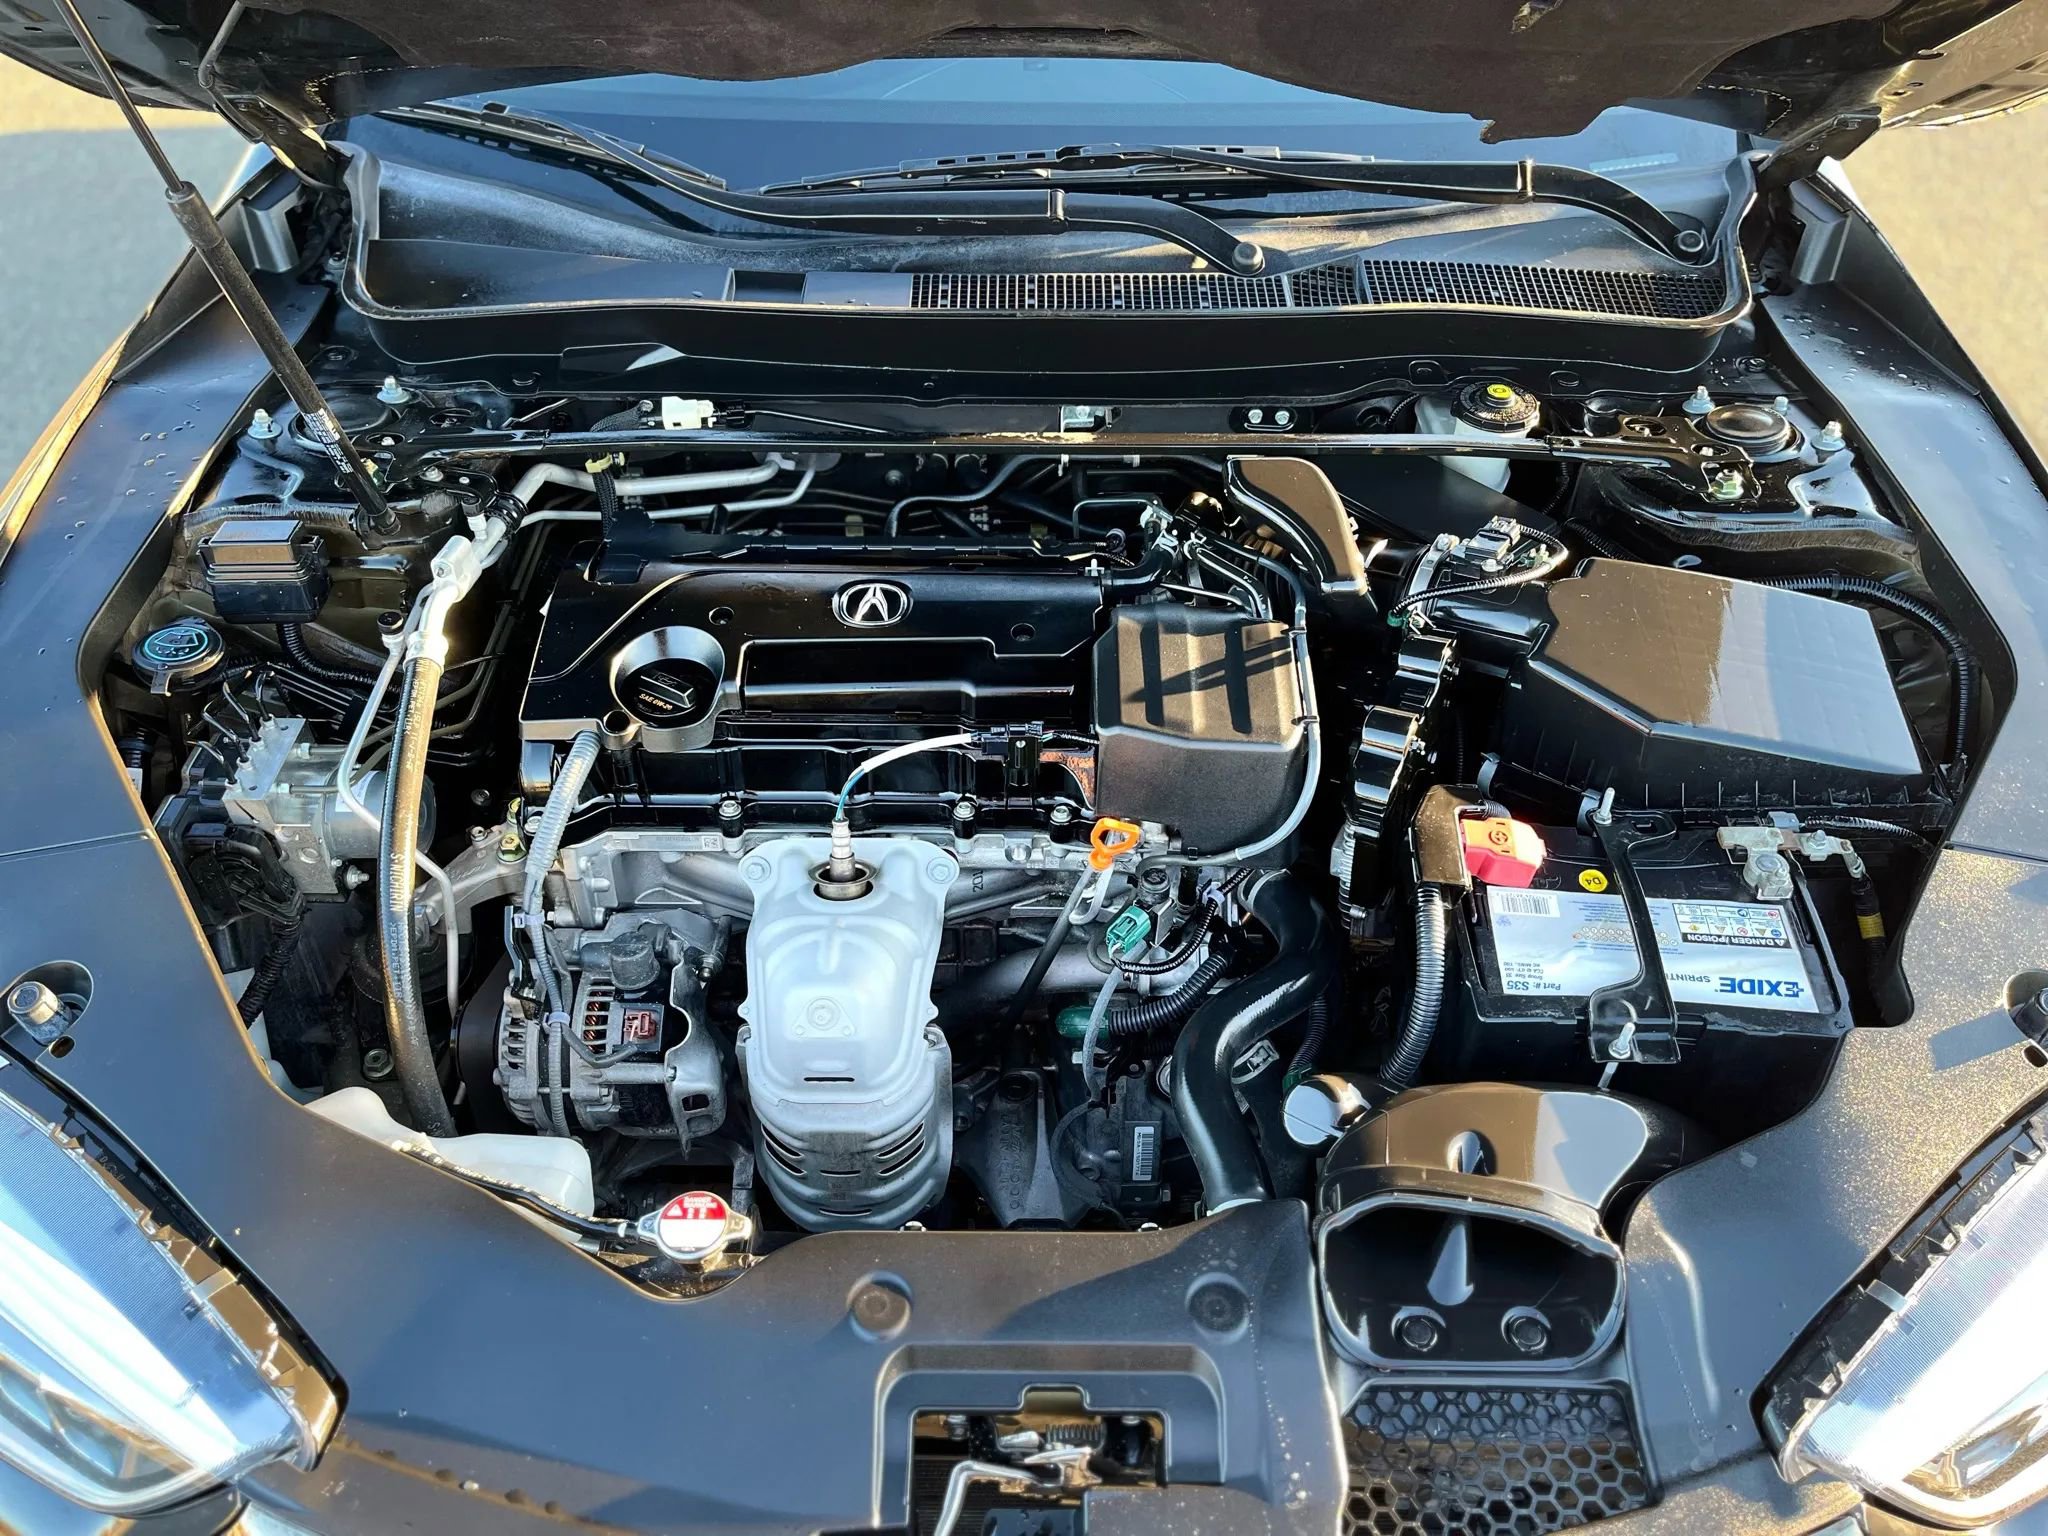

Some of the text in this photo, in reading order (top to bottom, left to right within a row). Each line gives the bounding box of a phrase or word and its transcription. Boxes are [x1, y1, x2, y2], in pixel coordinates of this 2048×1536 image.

[639, 693, 653, 702] SAE
[1585, 876, 1602, 886] D4
[1731, 936, 1775, 946] DANGER
[1507, 981, 1529, 990] S35
[1665, 973, 1805, 998] EXIDE SPRINT
